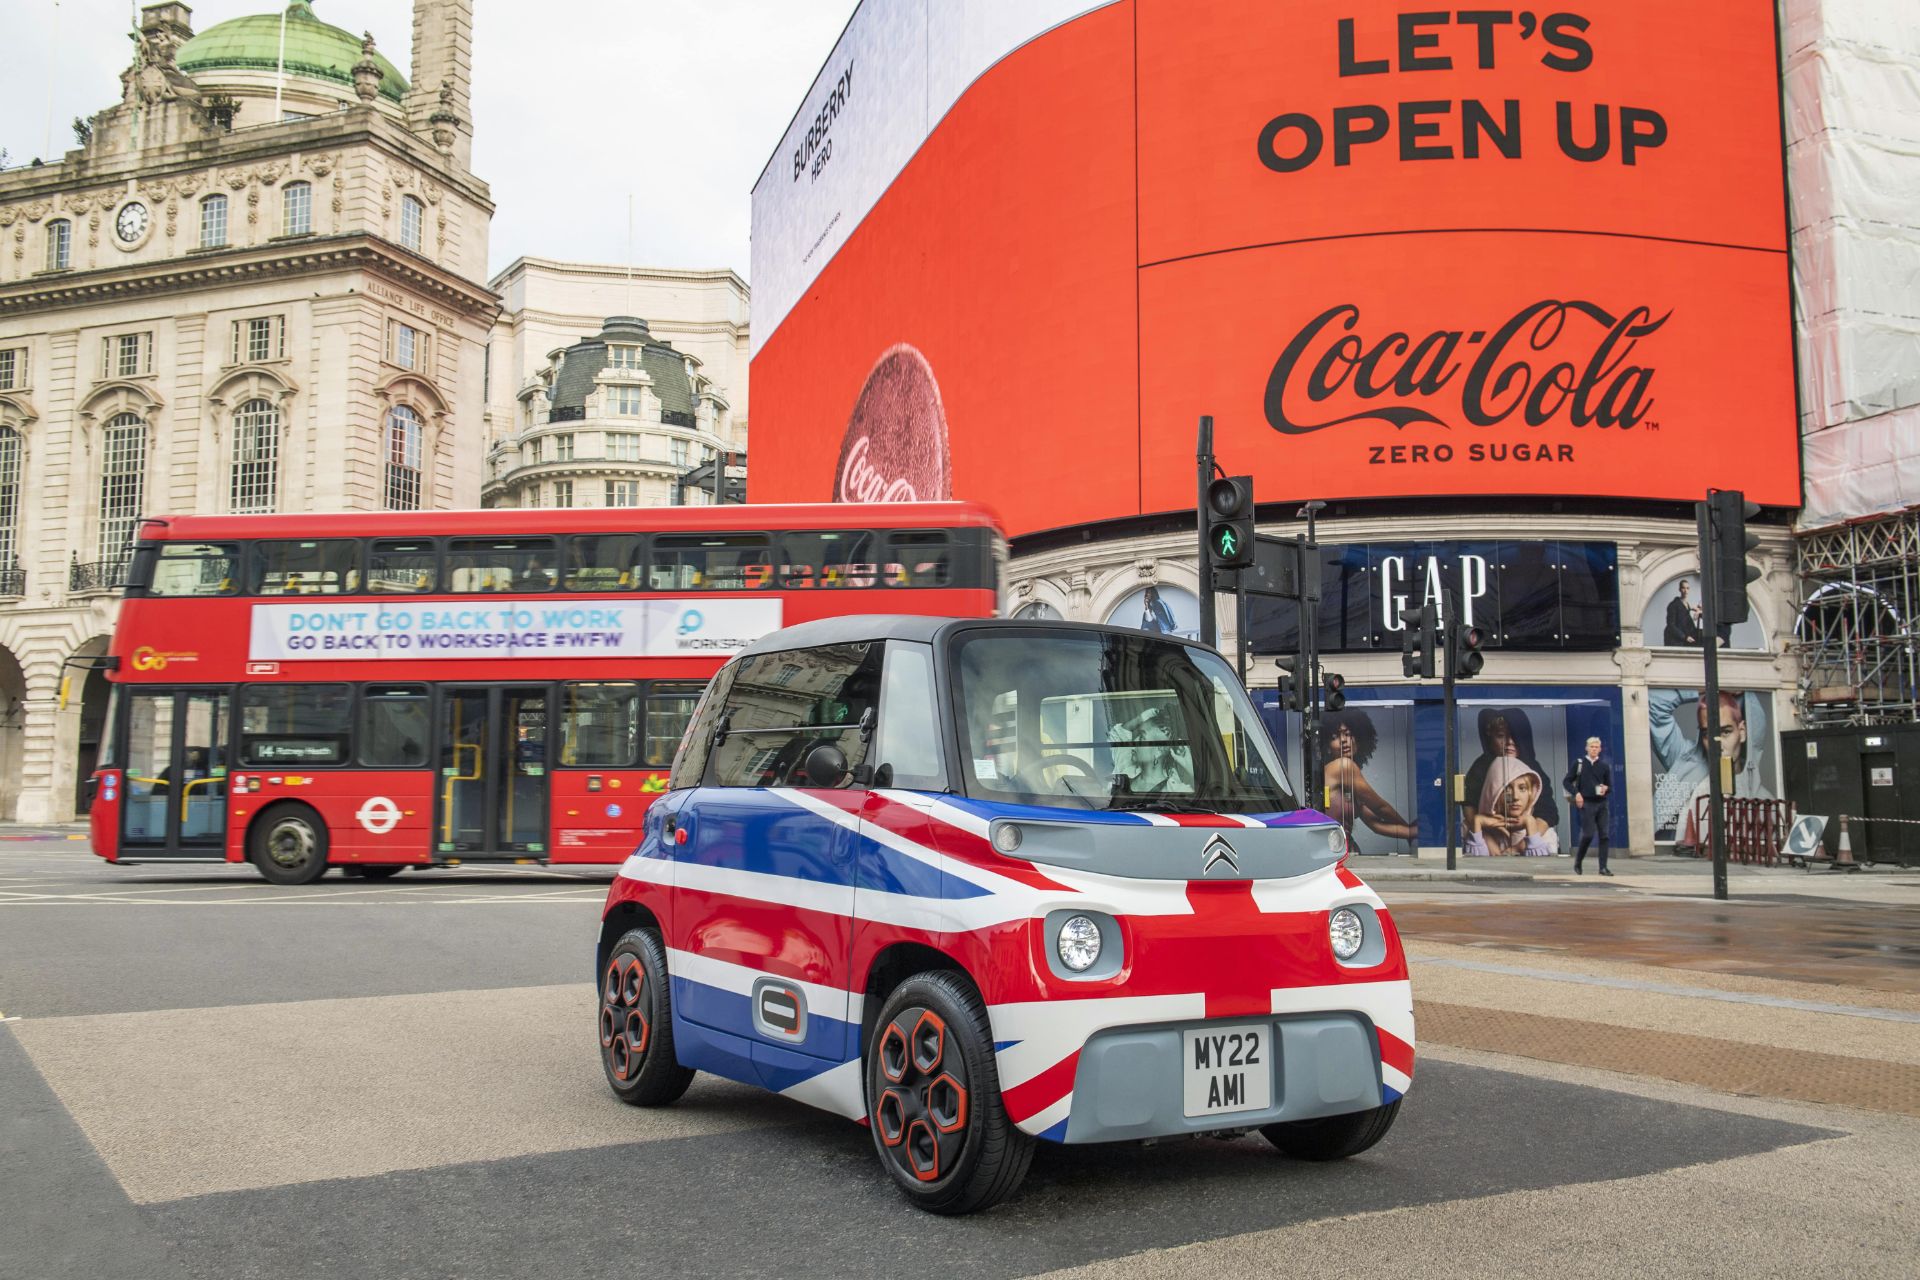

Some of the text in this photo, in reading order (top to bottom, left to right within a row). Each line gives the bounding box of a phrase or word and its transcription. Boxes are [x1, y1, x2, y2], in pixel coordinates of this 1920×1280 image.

[1337, 10, 1594, 78] LET'S
[793, 59, 855, 184] BURBERRY
[1256, 99, 1668, 174] OPEN UP
[811, 138, 833, 185] HERO
[367, 281, 455, 329] ALLIANCE LIFE OFFICE
[1263, 299, 1675, 435] Coca-Cola
[1369, 443, 1575, 465] ZERO SUGAR
[1382, 554, 1487, 632] GAP
[287, 632, 624, 650] GO BACK TO WORKSPACE #WFW
[289, 609, 624, 632] DON'T GO BACK TO WORK
[1654, 773, 1677, 782] YOUR
[1194, 1032, 1260, 1070] MY22
[1207, 1072, 1246, 1109] AMI
